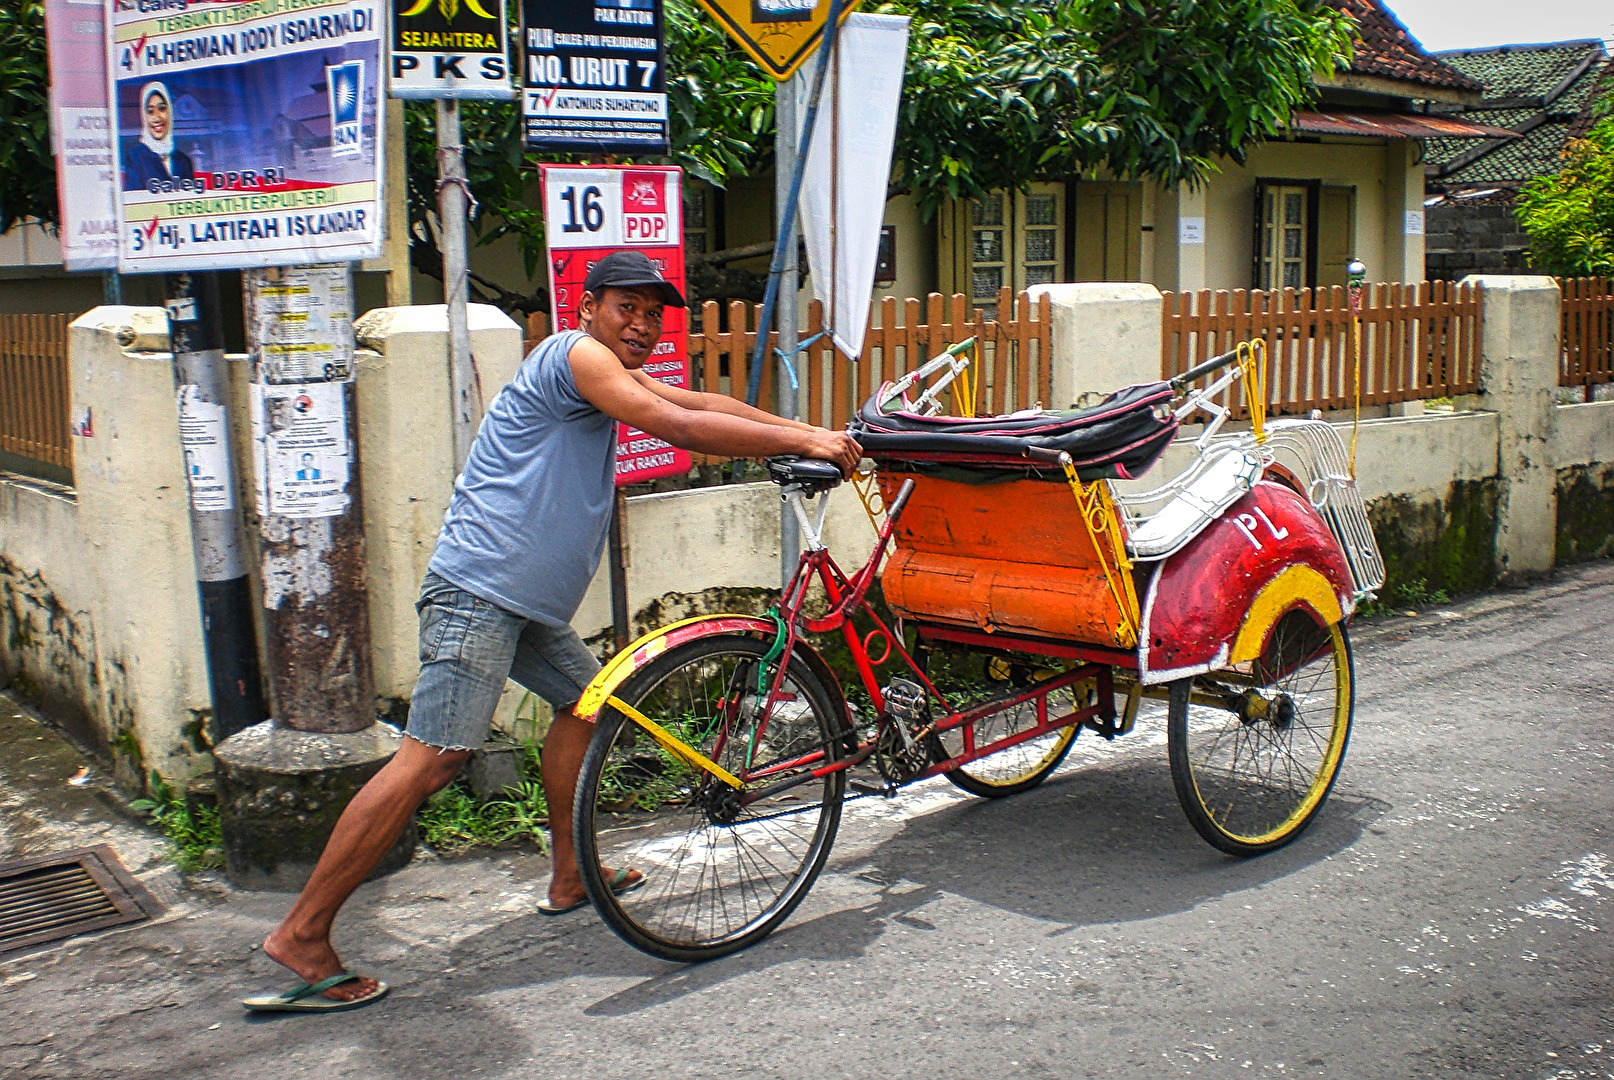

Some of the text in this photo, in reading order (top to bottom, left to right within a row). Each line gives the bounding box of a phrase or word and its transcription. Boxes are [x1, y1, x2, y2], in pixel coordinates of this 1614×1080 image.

[594, 7, 618, 22] PAK
[400, 31, 498, 48] SEJAHTERA
[121, 47, 133, 71] 4
[528, 54, 658, 88] NO. URUT 7
[528, 92, 541, 111] 7
[556, 96, 603, 110] ANTONIUS
[146, 165, 287, 195] Caleg DPR RI
[560, 185, 605, 233] 16
[132, 208, 367, 251] 3 Hj. LATIFAH ISKANDAR
[627, 216, 666, 238] PDP
[556, 287, 568, 308] 2
[615, 459, 636, 474] TUK
